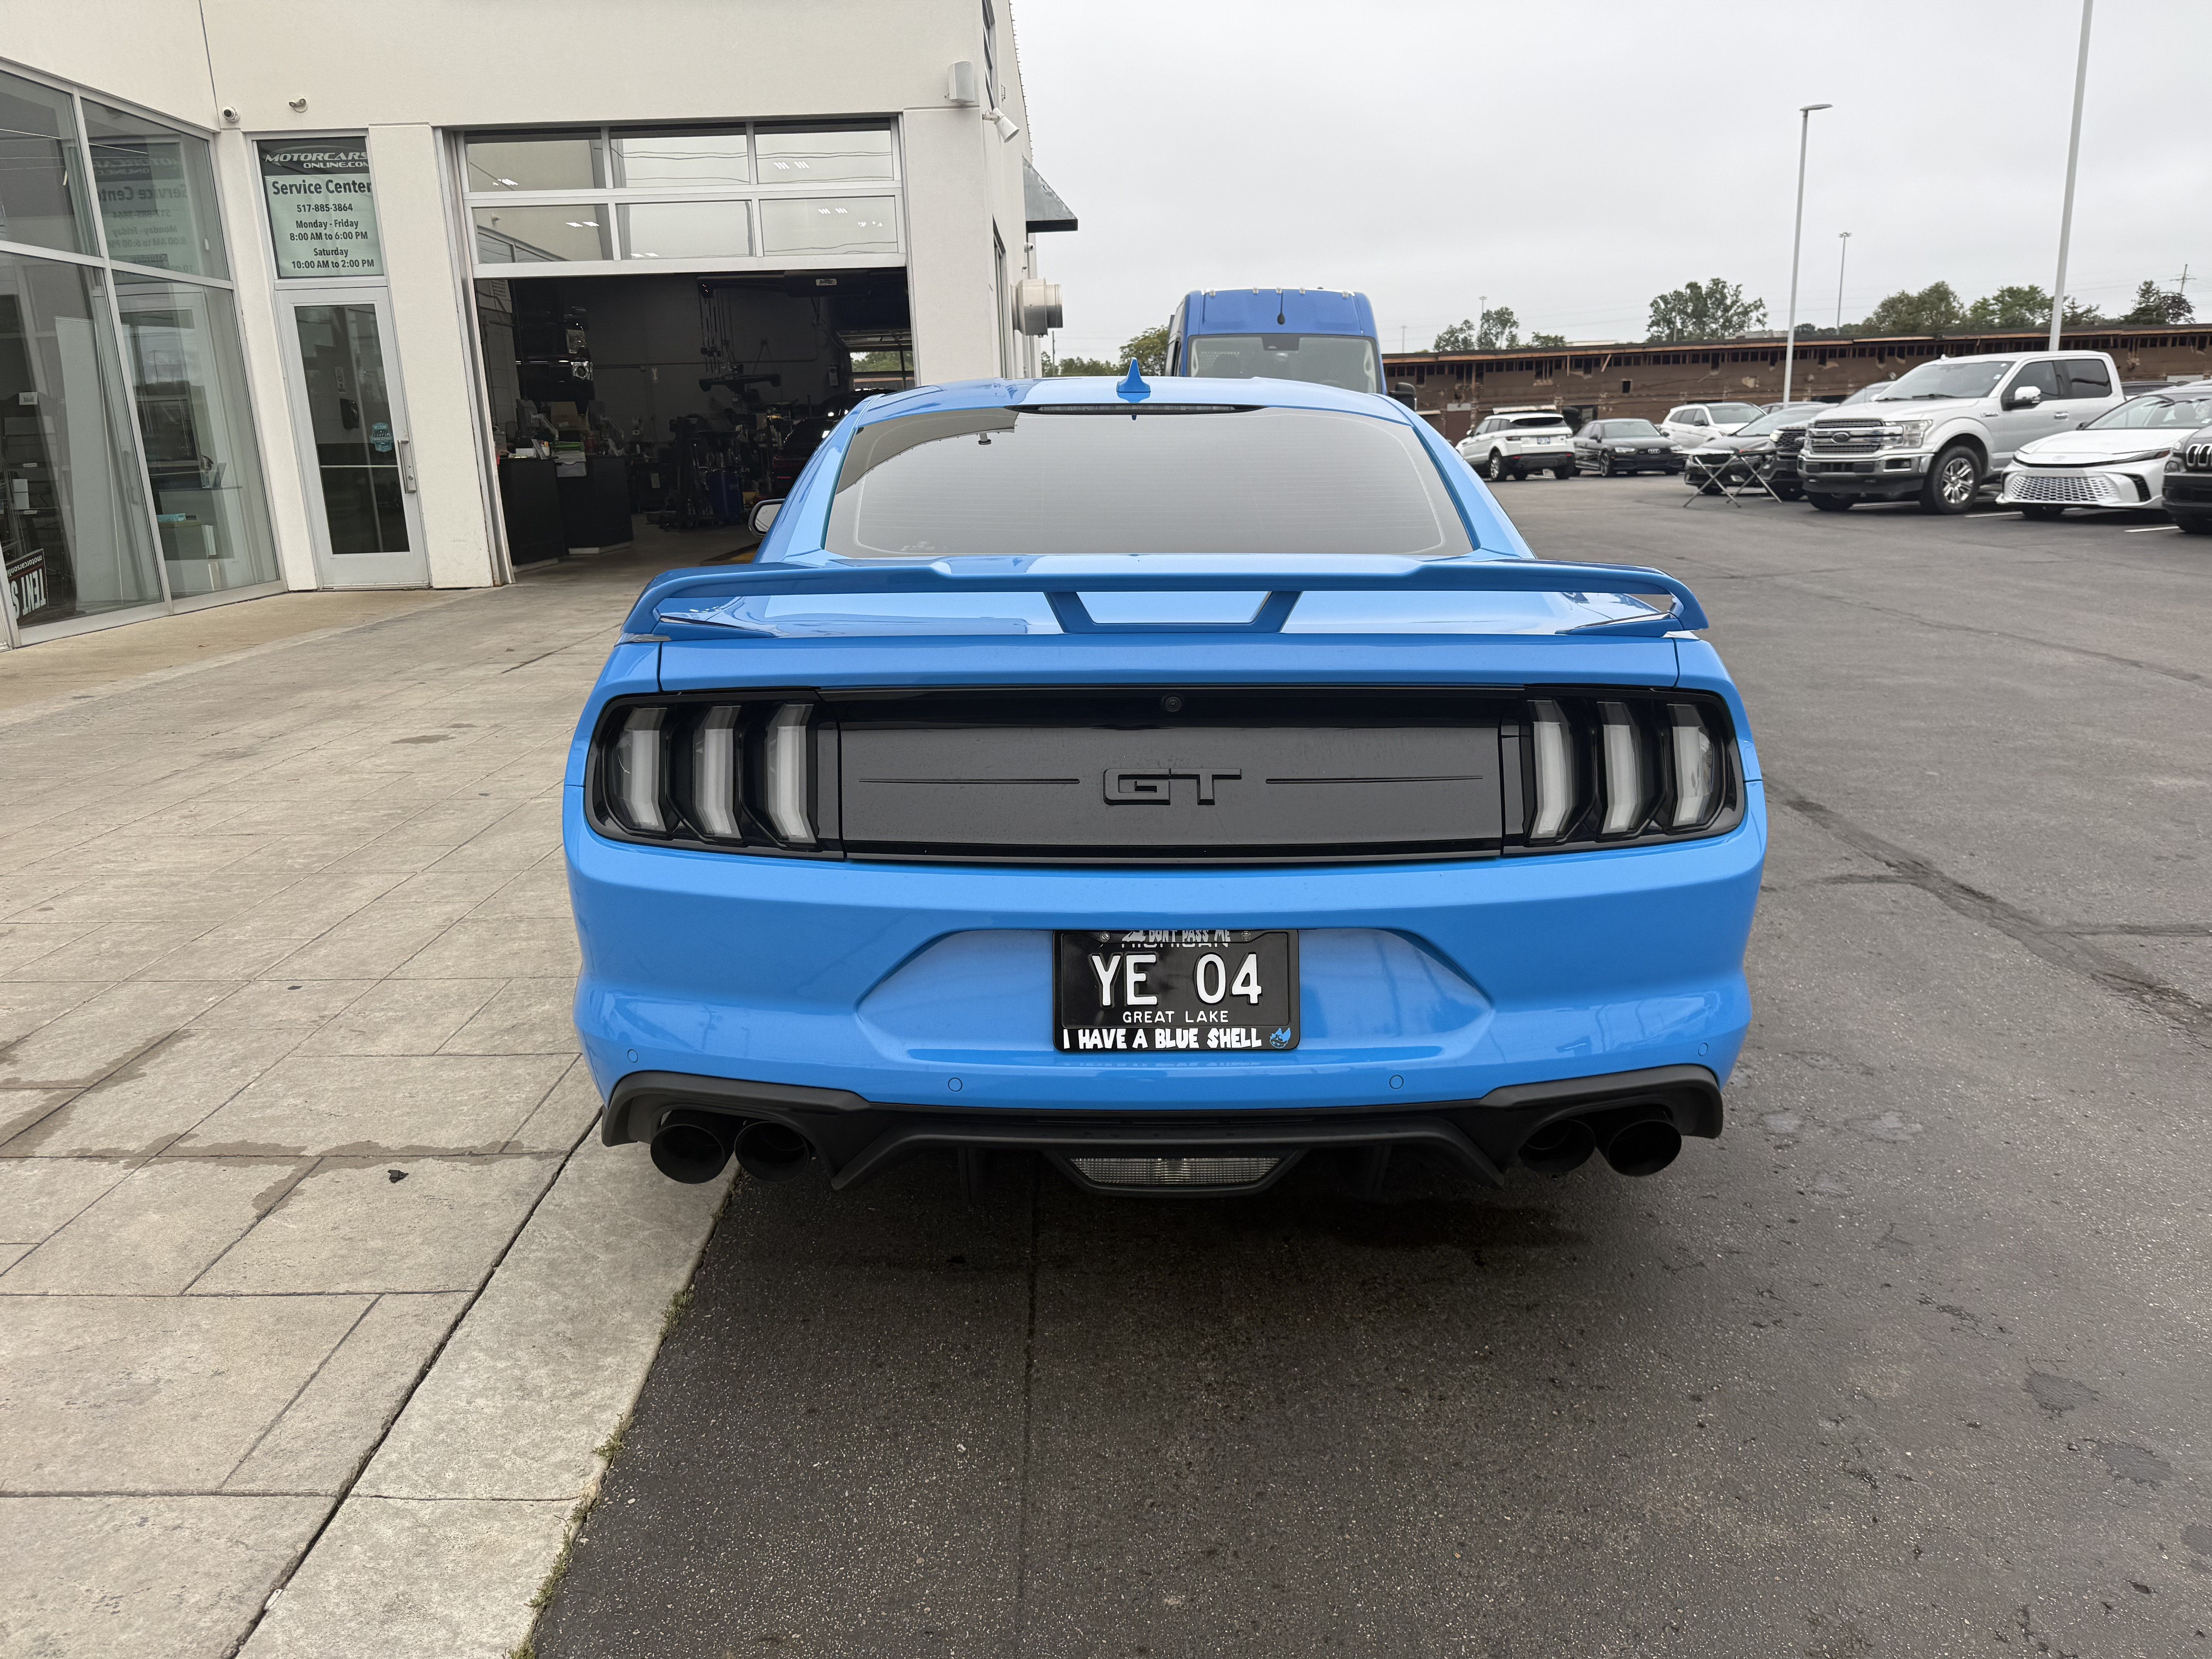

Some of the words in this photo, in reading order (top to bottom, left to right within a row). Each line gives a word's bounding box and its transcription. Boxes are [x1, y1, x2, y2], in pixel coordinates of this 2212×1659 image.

[265, 152, 368, 162] MOTORCARS
[272, 179, 322, 195] Service
[326, 179, 372, 194] Center
[297, 203, 353, 212] 517-885-3864
[295, 220, 327, 230] Monday
[334, 219, 358, 229] Friday
[356, 231, 368, 239] PM
[314, 247, 348, 257] Saturday
[21, 568, 46, 616] TENT
[1103, 768, 1242, 805] GT
[1182, 929, 1210, 942] PASS
[1214, 929, 1231, 942] ME
[1092, 955, 1158, 1006] YE
[1123, 1010, 1175, 1023] GREAT
[1185, 1010, 1228, 1023] LAKE
[1063, 1029, 1070, 1049] I
[1078, 1029, 1126, 1049] HAVE
[1132, 1029, 1148, 1049] A
[1155, 1028, 1199, 1049] BLUE
[1207, 1028, 1262, 1048] SHELL
